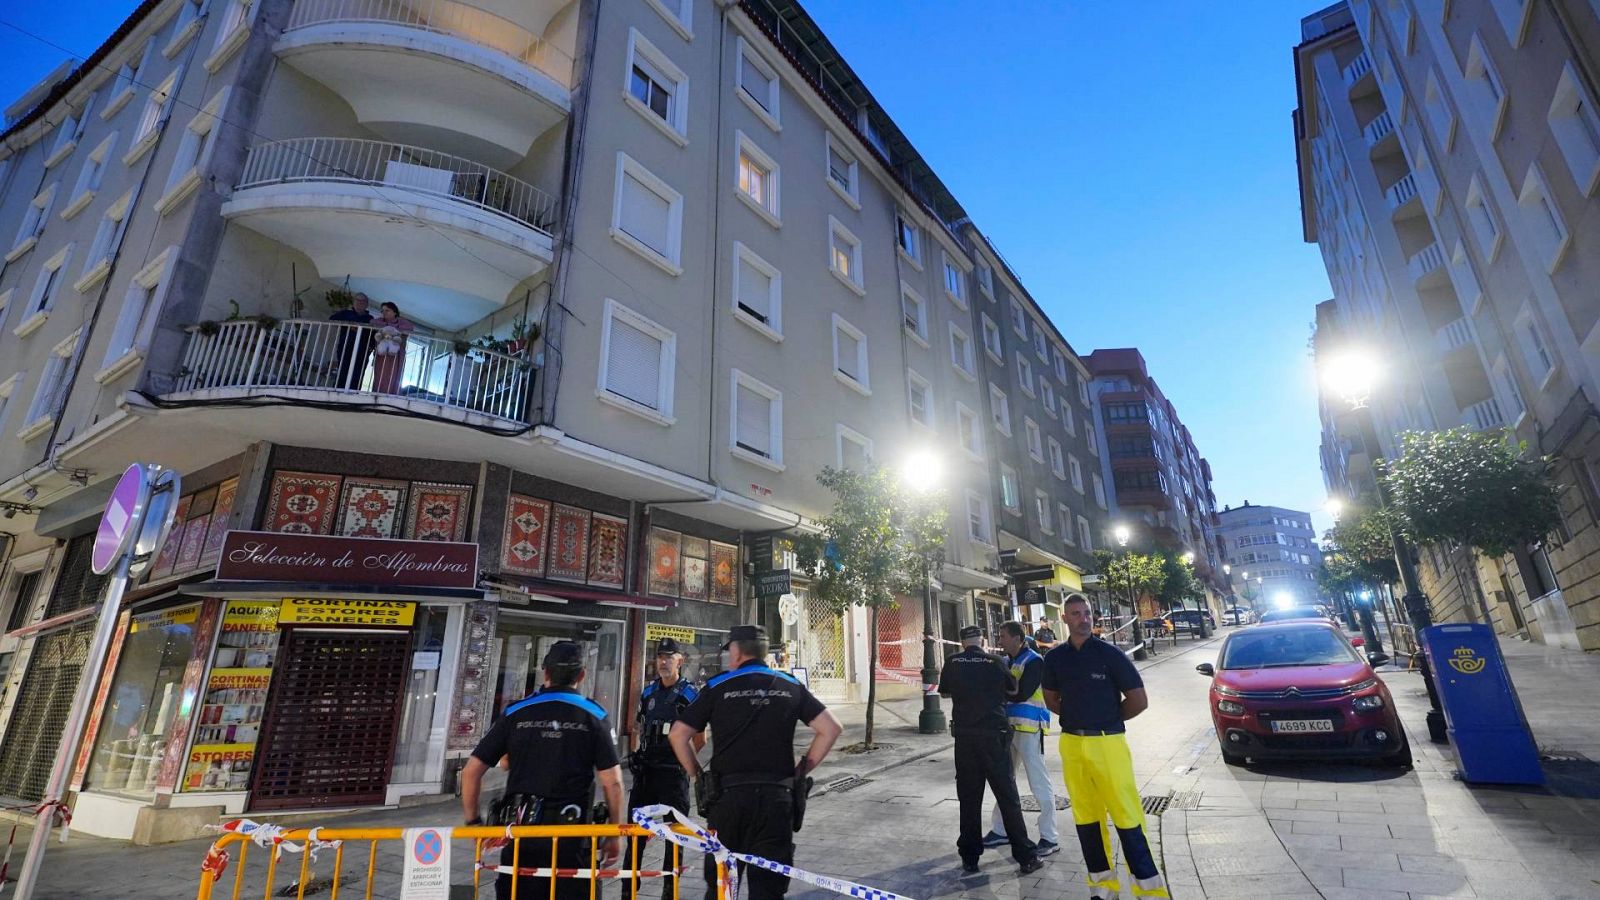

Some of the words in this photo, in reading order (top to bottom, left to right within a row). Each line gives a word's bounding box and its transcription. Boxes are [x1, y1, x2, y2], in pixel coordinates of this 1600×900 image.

[229, 541, 326, 567] Selección
[332, 550, 354, 569] de
[363, 550, 469, 578] Alfombras
[292, 599, 408, 609] CORTINAS
[296, 607, 401, 617] ESTORES
[296, 615, 398, 625] PANELES
[647, 625, 693, 634] CORTINAS
[211, 675, 270, 684] CORTINAS
[1280, 721, 1306, 731] 4699
[1309, 721, 1331, 731] KCC
[191, 750, 253, 763] STORES
[410, 880, 443, 888] ESTACIONAR
